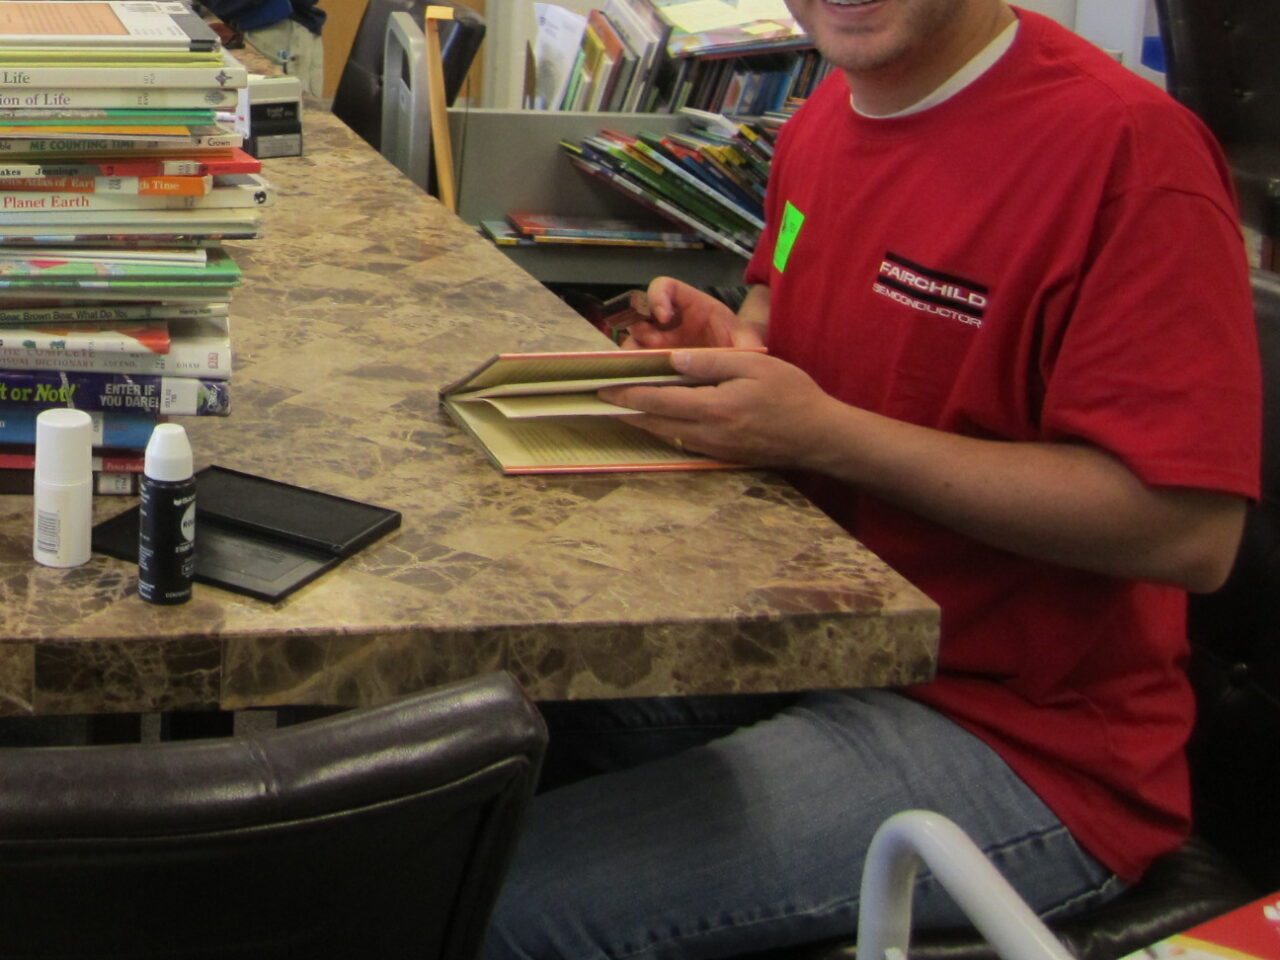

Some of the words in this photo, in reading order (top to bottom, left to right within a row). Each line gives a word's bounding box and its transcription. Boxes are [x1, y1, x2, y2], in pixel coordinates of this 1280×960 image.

[4, 71, 31, 84] Life
[24, 93, 40, 106] of
[43, 93, 71, 106] Life
[30, 141, 46, 150] ME
[49, 140, 108, 150] COUNTING
[207, 137, 231, 146] Crown
[72, 178, 95, 188] Eart
[152, 180, 180, 190] Time
[3, 196, 47, 208] Planet
[51, 196, 90, 208] Earth
[880, 261, 987, 307] FAIRCHILD
[872, 282, 982, 328] SEMICONDUCTOR
[24, 312, 52, 321] Brown
[76, 311, 98, 320] What
[100, 310, 113, 319] Do
[35, 358, 95, 367] DICTIONARY
[11, 388, 32, 401] or
[35, 383, 76, 402] Not!
[105, 384, 141, 395] ENTER
[144, 384, 155, 395] IF
[100, 395, 122, 406] YOU
[125, 396, 159, 408] DARE!
